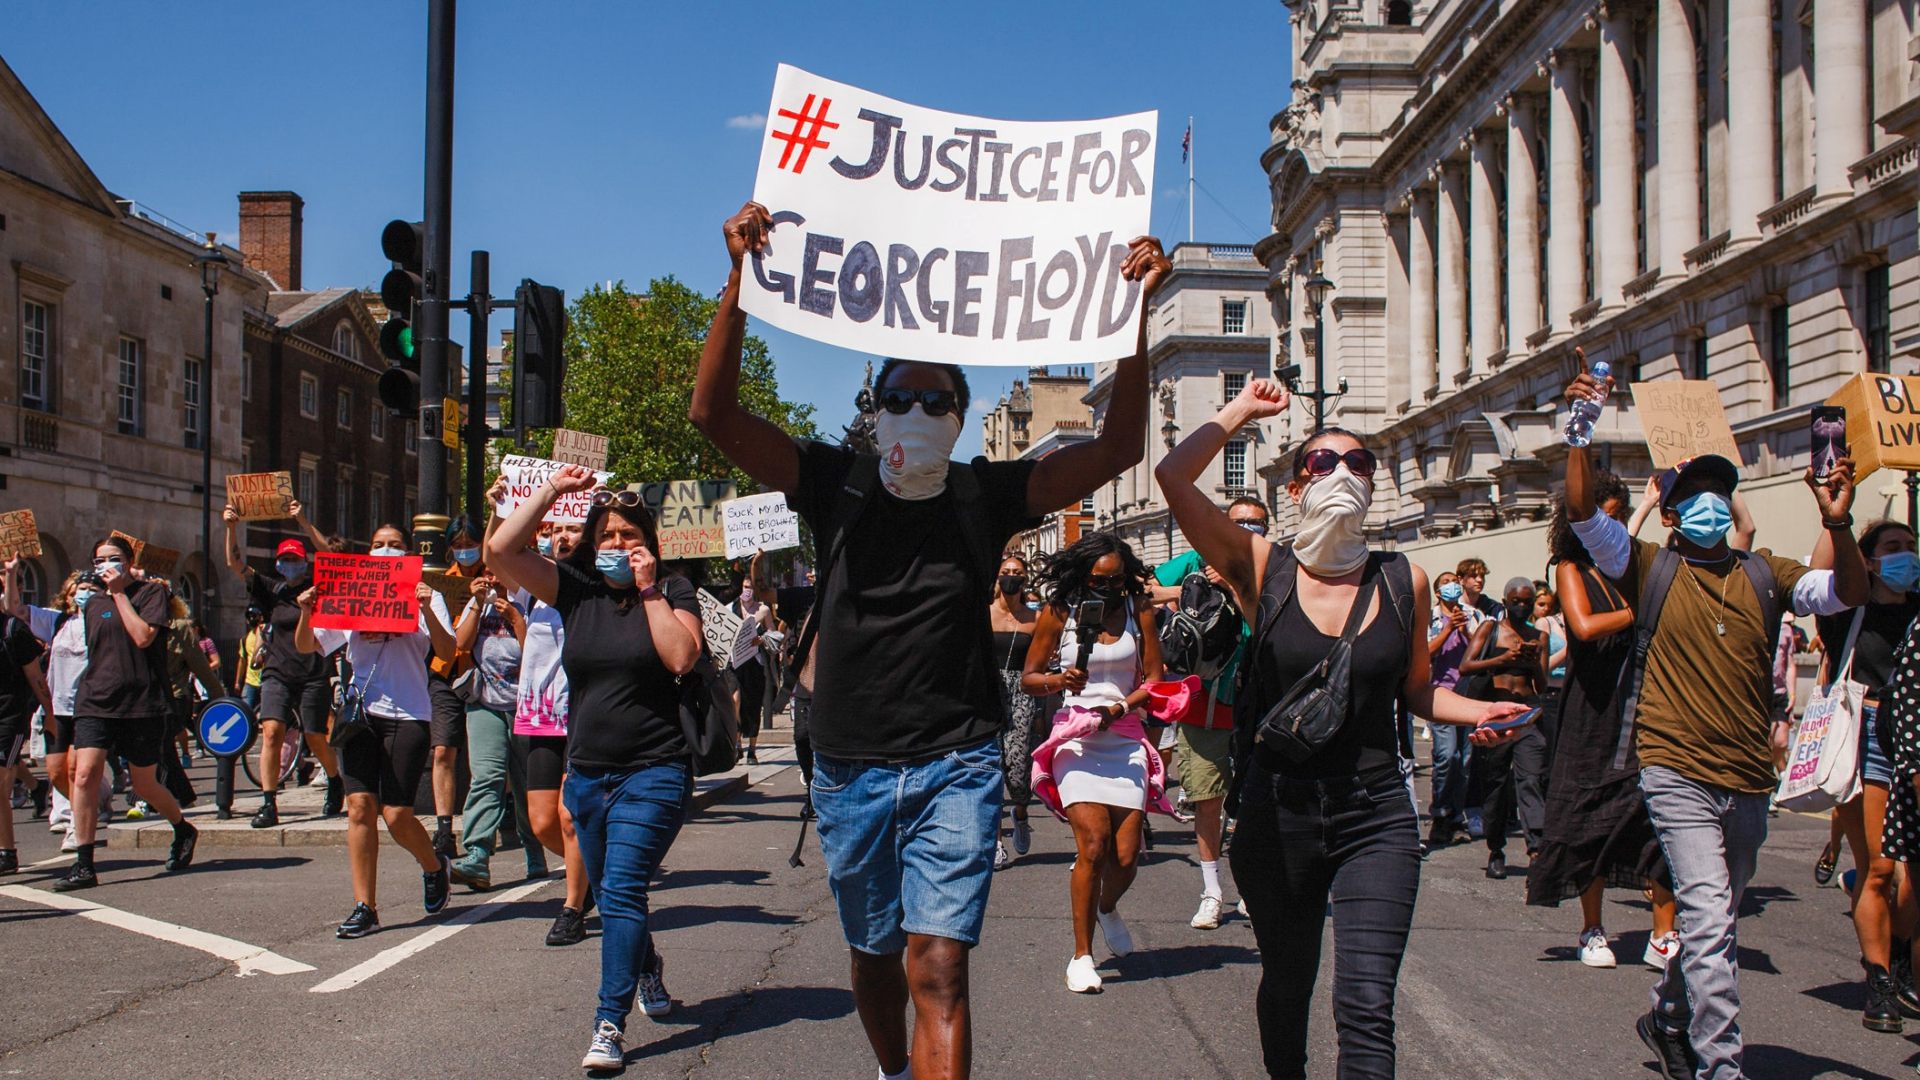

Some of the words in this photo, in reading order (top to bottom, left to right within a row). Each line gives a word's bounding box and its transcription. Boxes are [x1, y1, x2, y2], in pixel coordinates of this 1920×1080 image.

[1066, 128, 1151, 202] FOR
[751, 210, 989, 337] GEORGE
[992, 231, 1142, 342] FLOYD
[1875, 376, 1920, 414] BL
[556, 431, 568, 448] NO
[571, 432, 607, 454] JUSTICE
[1877, 421, 1920, 447] LIV
[240, 474, 277, 493] JUSTICE
[518, 469, 555, 485] MAT
[511, 485, 532, 498] NO
[245, 493, 279, 516] PEACE
[758, 505, 771, 514] MY
[660, 504, 722, 528] EATH
[671, 541, 708, 556] FLOYD
[729, 536, 755, 550] FUCK
[317, 556, 357, 568] THERE
[358, 560, 391, 570] COMES
[395, 561, 404, 571] A
[318, 569, 353, 580] TIME
[356, 571, 390, 581] WHEN
[316, 581, 378, 598] SILENCE
[382, 582, 398, 599] IS
[321, 598, 415, 619] BETRAYAL
